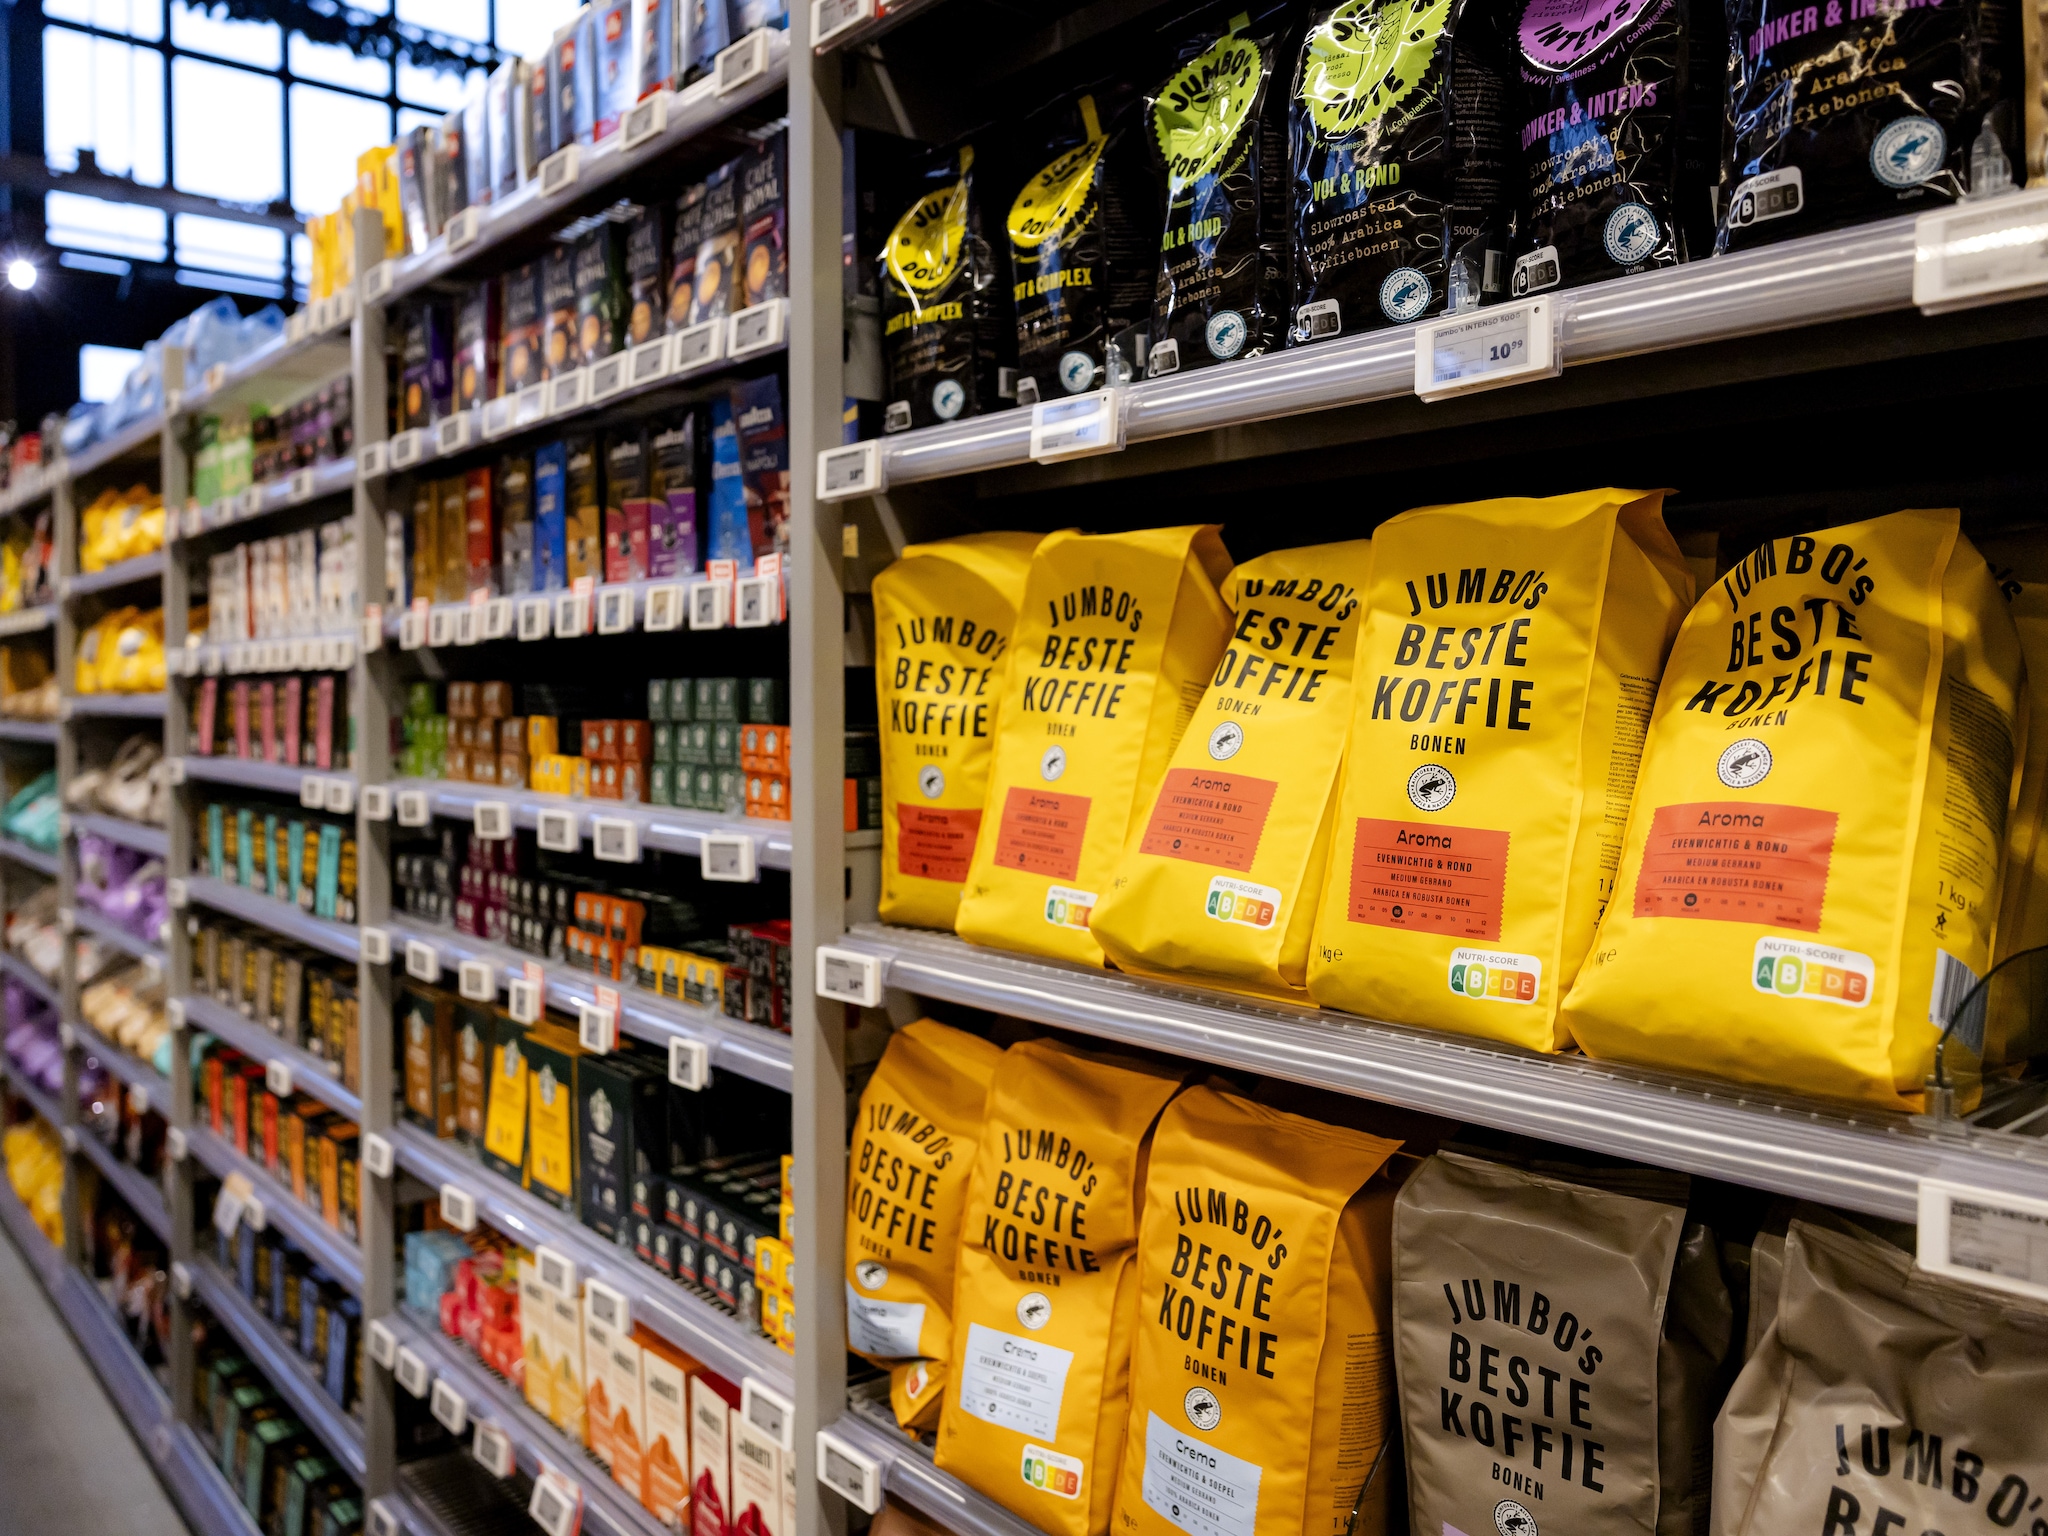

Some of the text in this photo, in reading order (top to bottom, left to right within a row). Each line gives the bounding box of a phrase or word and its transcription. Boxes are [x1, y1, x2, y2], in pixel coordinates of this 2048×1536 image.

[1749, 0, 1843, 60] DONKER &
[1554, 62, 1596, 85] Sweetness
[1391, 95, 1434, 131] Complexity
[1521, 82, 1658, 151] DONKER & INTENS
[1529, 126, 1620, 180] Slowroasted
[1313, 163, 1401, 202] VOL & ROND
[1530, 174, 1554, 199] 00%
[1560, 149, 1626, 184] Arabica
[1310, 199, 1396, 236] Slowroasted
[1608, 207, 1655, 240] RAINFOREST ALLIANCE
[1177, 217, 1222, 246] & ROND
[1341, 218, 1403, 244] Arabica
[1453, 225, 1480, 237] 500g
[1312, 238, 1400, 274] Koffiebonen
[1634, 236, 1655, 259] NATURE
[1036, 267, 1092, 294] COMPLEX
[1178, 266, 1224, 290] Arabica
[1625, 264, 1645, 276] Koffie
[1384, 272, 1428, 300] RAINFOREST ALLIANCE
[1407, 298, 1426, 317] NATURE
[1435, 327, 1464, 339] Jumbo's
[1465, 318, 1498, 332] INTENSO
[1235, 578, 1358, 622] UMBO's
[1235, 608, 1341, 661] ESTE
[1394, 618, 1531, 670] BESTE
[1726, 597, 1862, 673] BESTE
[1040, 634, 1135, 675] BESTE
[895, 656, 992, 696] BESTE
[1214, 648, 1328, 703] OFFIE
[1684, 649, 1873, 717] KOFFIE
[1023, 676, 1126, 719] KOFFIE
[1217, 697, 1262, 717] BONEN
[1371, 675, 1534, 731] KOFFIE
[891, 699, 988, 737] KOFFIE
[1047, 721, 1077, 738] BONEN
[1725, 709, 1788, 731] BONEN
[1410, 734, 1466, 755] BONEN
[1721, 741, 1769, 766] RAINFOREST ALLIANCE
[1191, 775, 1232, 794] Aroma
[1410, 767, 1453, 792] RAINFOREST ALLIANCE
[1721, 769, 1765, 785] PEOPLE NATURE
[1029, 796, 1060, 811] Aroma
[1222, 802, 1243, 814] ROND
[1411, 791, 1451, 808] PEOPLE NATURE
[1698, 810, 1765, 828] Aroma
[1216, 831, 1235, 842] BONEN
[1396, 829, 1452, 849] Aroma
[1671, 839, 1788, 853] EVENWICHTIG & ROND
[1376, 853, 1473, 873] EVENWICHTIG & ROND
[1686, 858, 1761, 870] MEDIUM GEBRAND
[1215, 879, 1264, 897] NUTRI-SCORE
[1391, 873, 1452, 888] MEDIUM GEBRAND
[1662, 875, 1784, 891] ARABICA EN ROBUSTA BONEN
[1221, 896, 1271, 921] B D E
[1373, 887, 1470, 907] ARABICA EN ROBUSTA BONEN
[1938, 881, 1966, 910] 1 kg
[1323, 947, 1332, 962] kg
[1457, 951, 1519, 966] NUTRI-SCORE
[1764, 942, 1845, 963] NUTRI-SCORE
[1469, 970, 1531, 994] B D E
[1780, 963, 1862, 994] B D E
[859, 1139, 939, 1211] BESTE
[851, 1178, 937, 1253] KOFFIE
[994, 1169, 1087, 1241] BESTE
[983, 1214, 1101, 1273] KOFFIE
[1019, 1269, 1061, 1288] BONEN
[1171, 1233, 1274, 1322] BESTE
[1159, 1282, 1278, 1380] KOFFIE
[1003, 1340, 1038, 1361] Crema
[1184, 1354, 1227, 1386] BONEN
[1449, 1331, 1593, 1431] BESTE
[1441, 1386, 1605, 1494] KOFFIE
[1175, 1439, 1217, 1470] Crema
[1158, 1449, 1236, 1498] EVENWICHTIG SOEPEL
[1491, 1461, 1544, 1501] BONEN
[1202, 1505, 1220, 1522] BONEN
